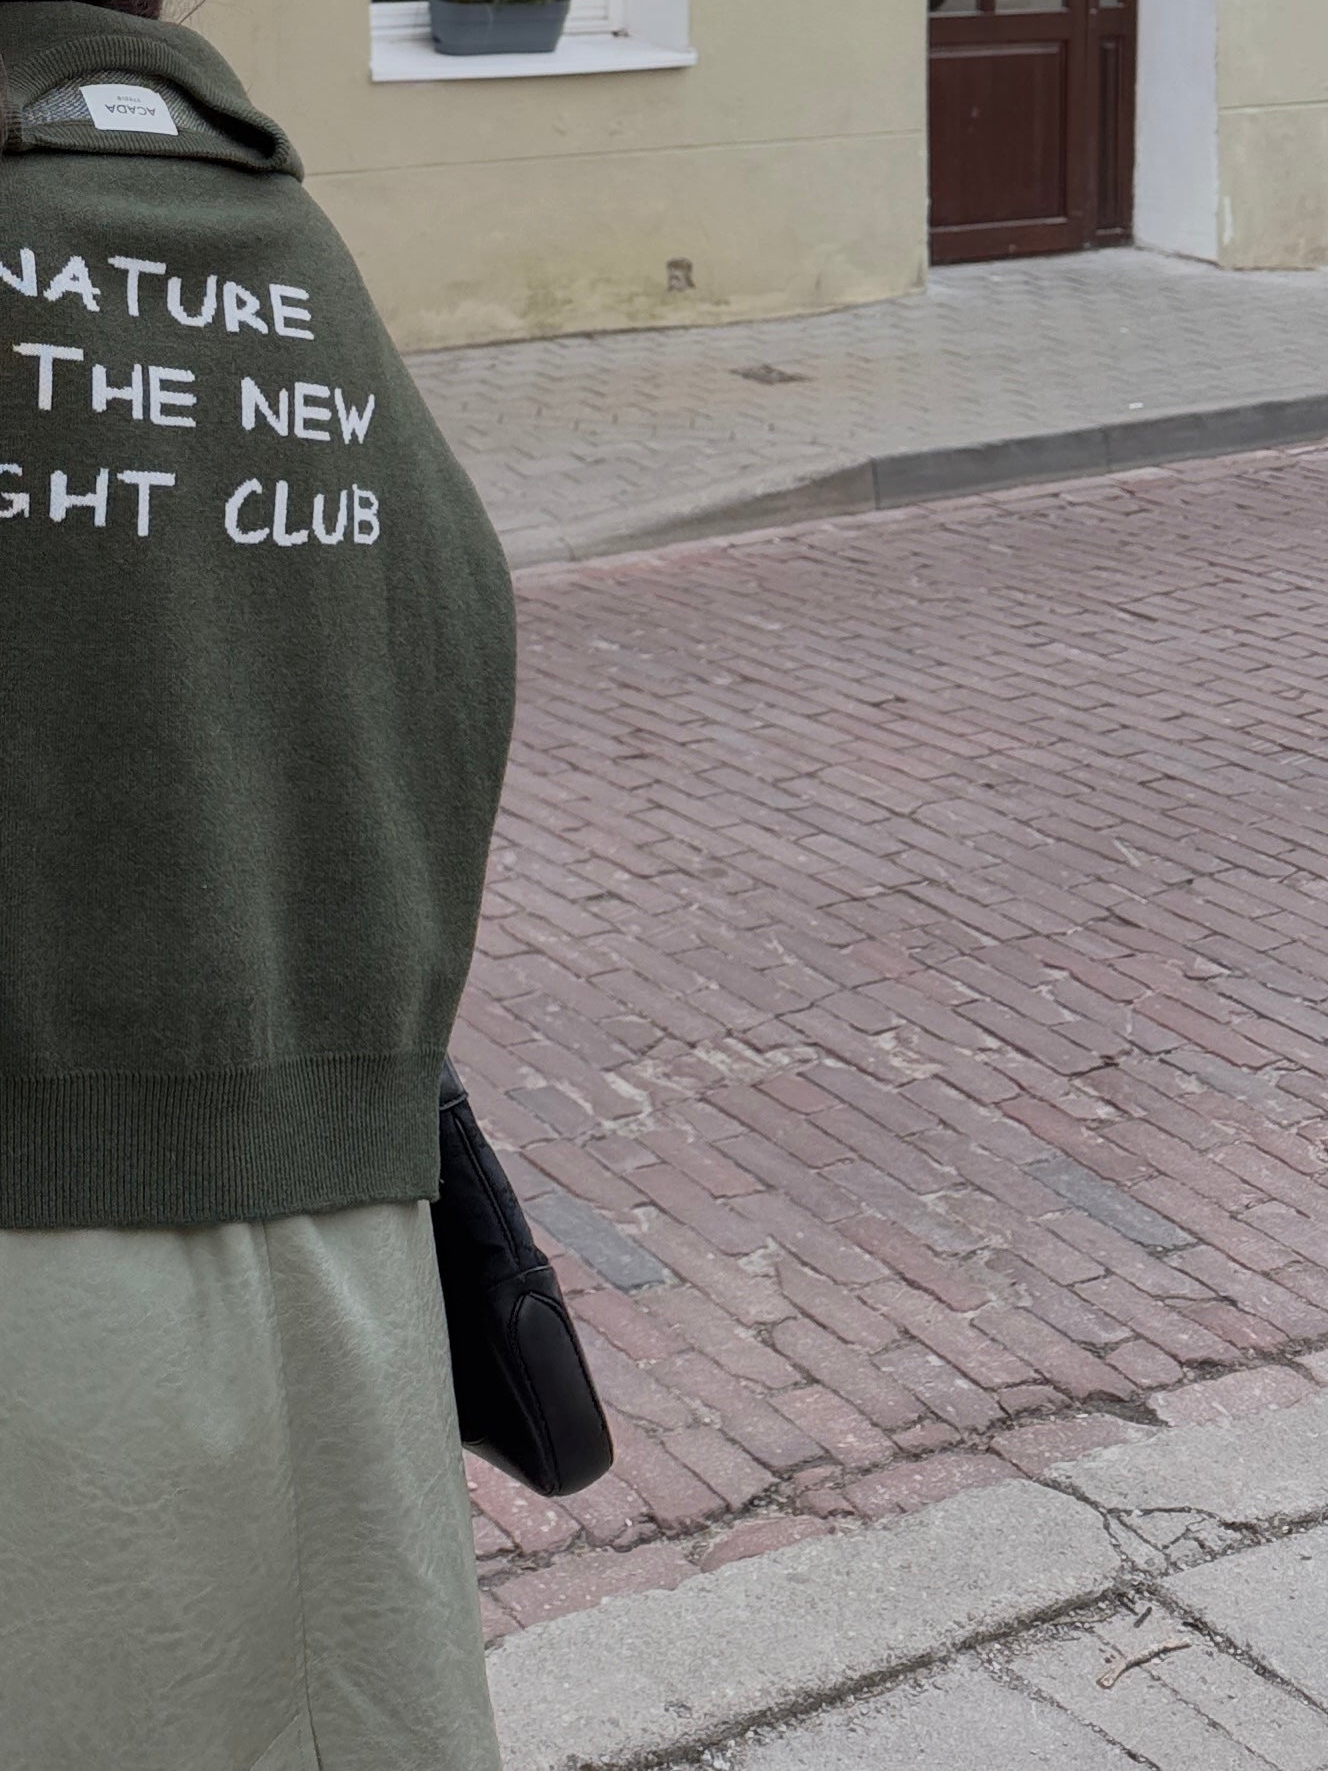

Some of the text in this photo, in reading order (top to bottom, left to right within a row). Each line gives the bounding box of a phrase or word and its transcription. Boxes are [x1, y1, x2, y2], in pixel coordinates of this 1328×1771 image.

[13, 342, 197, 428] THE
[240, 376, 376, 445] NEW
[224, 477, 380, 547] CLUB
